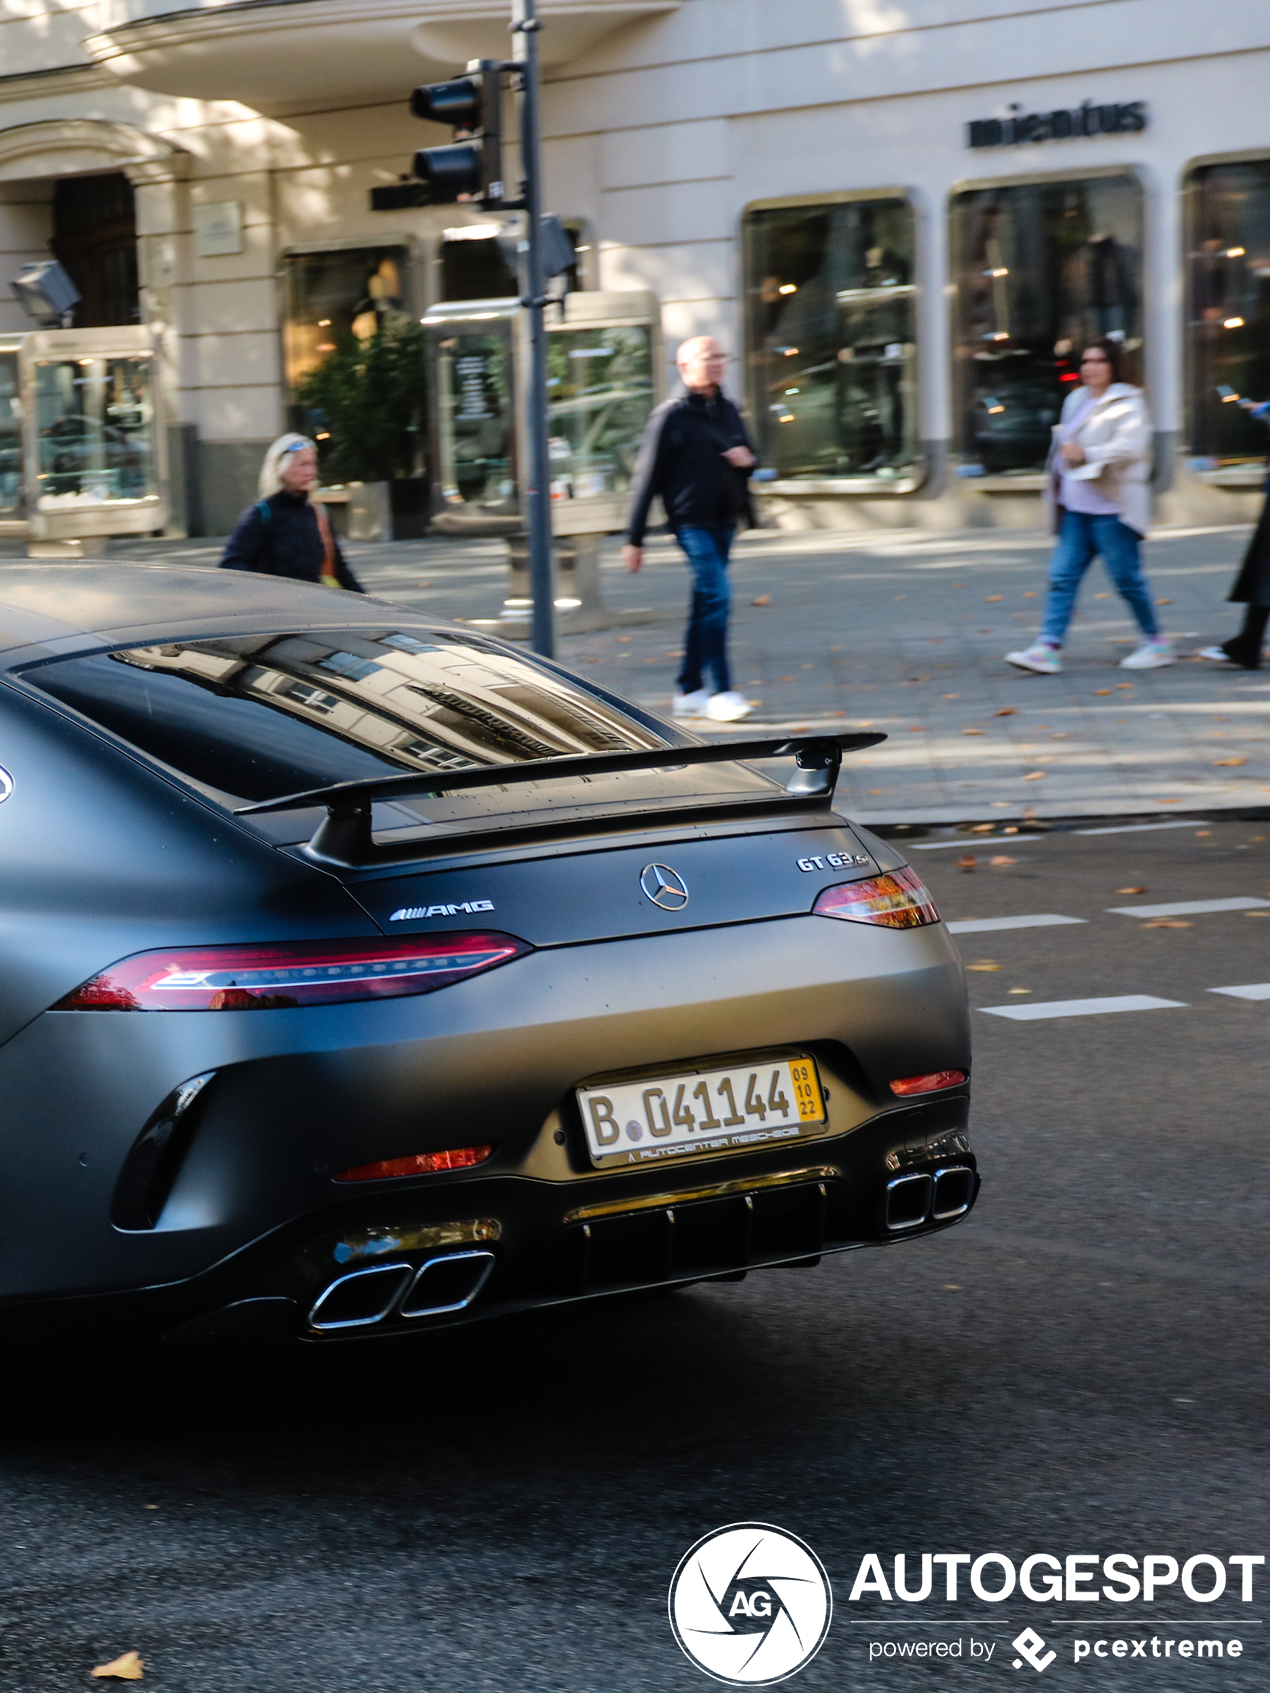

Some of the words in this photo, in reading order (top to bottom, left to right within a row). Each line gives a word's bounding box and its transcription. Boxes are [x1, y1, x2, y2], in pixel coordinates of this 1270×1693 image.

[964, 99, 1147, 148] mientus
[796, 856, 824, 872] GT
[425, 899, 496, 918] AMG
[792, 1065, 809, 1082] 09
[796, 1083, 812, 1098] 10
[642, 1069, 790, 1138] 041144
[799, 1099, 817, 1115] 22
[639, 1138, 729, 1160] AUTOCENTER
[731, 1127, 801, 1146] MESCHEDE
